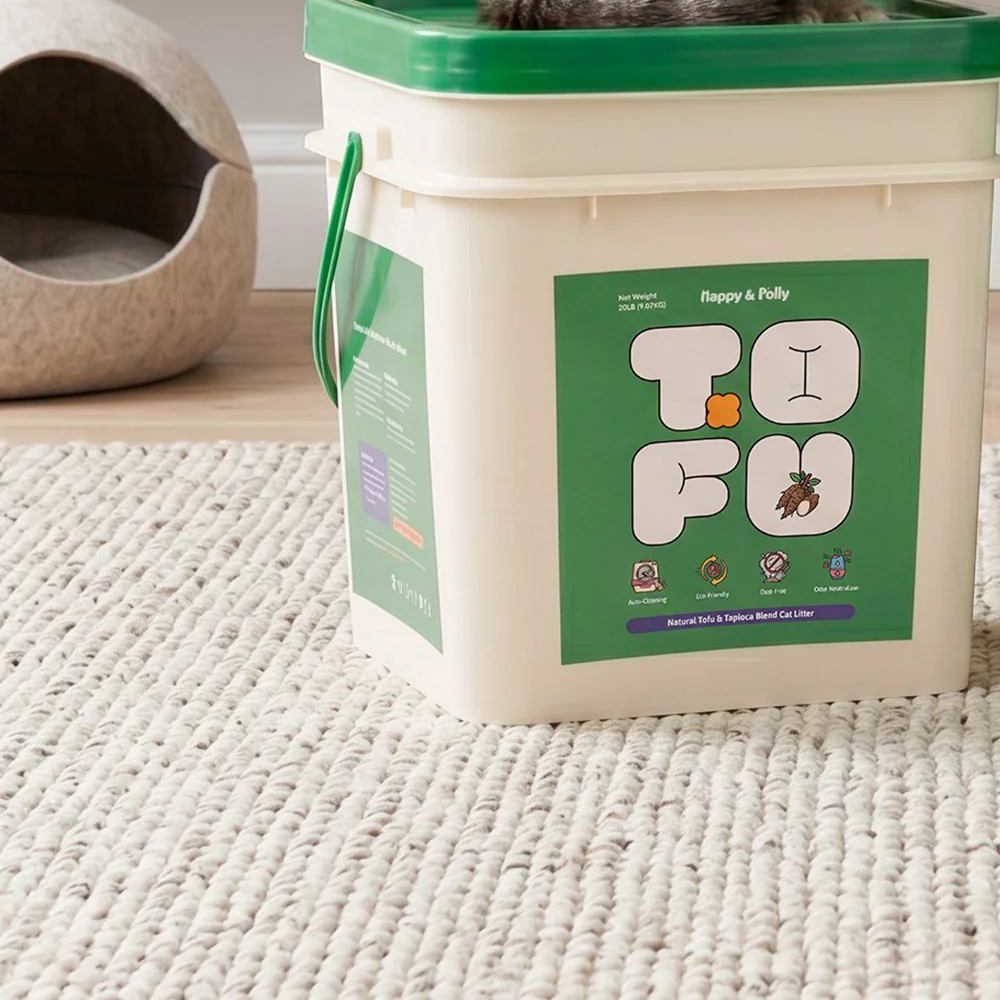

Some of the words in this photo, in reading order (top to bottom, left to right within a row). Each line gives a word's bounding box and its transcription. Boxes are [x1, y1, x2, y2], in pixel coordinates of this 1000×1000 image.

[617, 294, 632, 302] Net
[632, 292, 657, 302] Weight
[701, 289, 742, 304] Happy
[745, 289, 755, 301] &
[758, 286, 790, 301] Polly
[637, 301, 666, 311] (9.07KG)
[667, 616, 697, 627] Natural
[698, 615, 715, 624] Tofu
[716, 614, 723, 622] &
[724, 612, 754, 623] Tapioca
[756, 611, 778, 620] Blend
[779, 610, 793, 619] Cat
[794, 609, 814, 618] Litter
